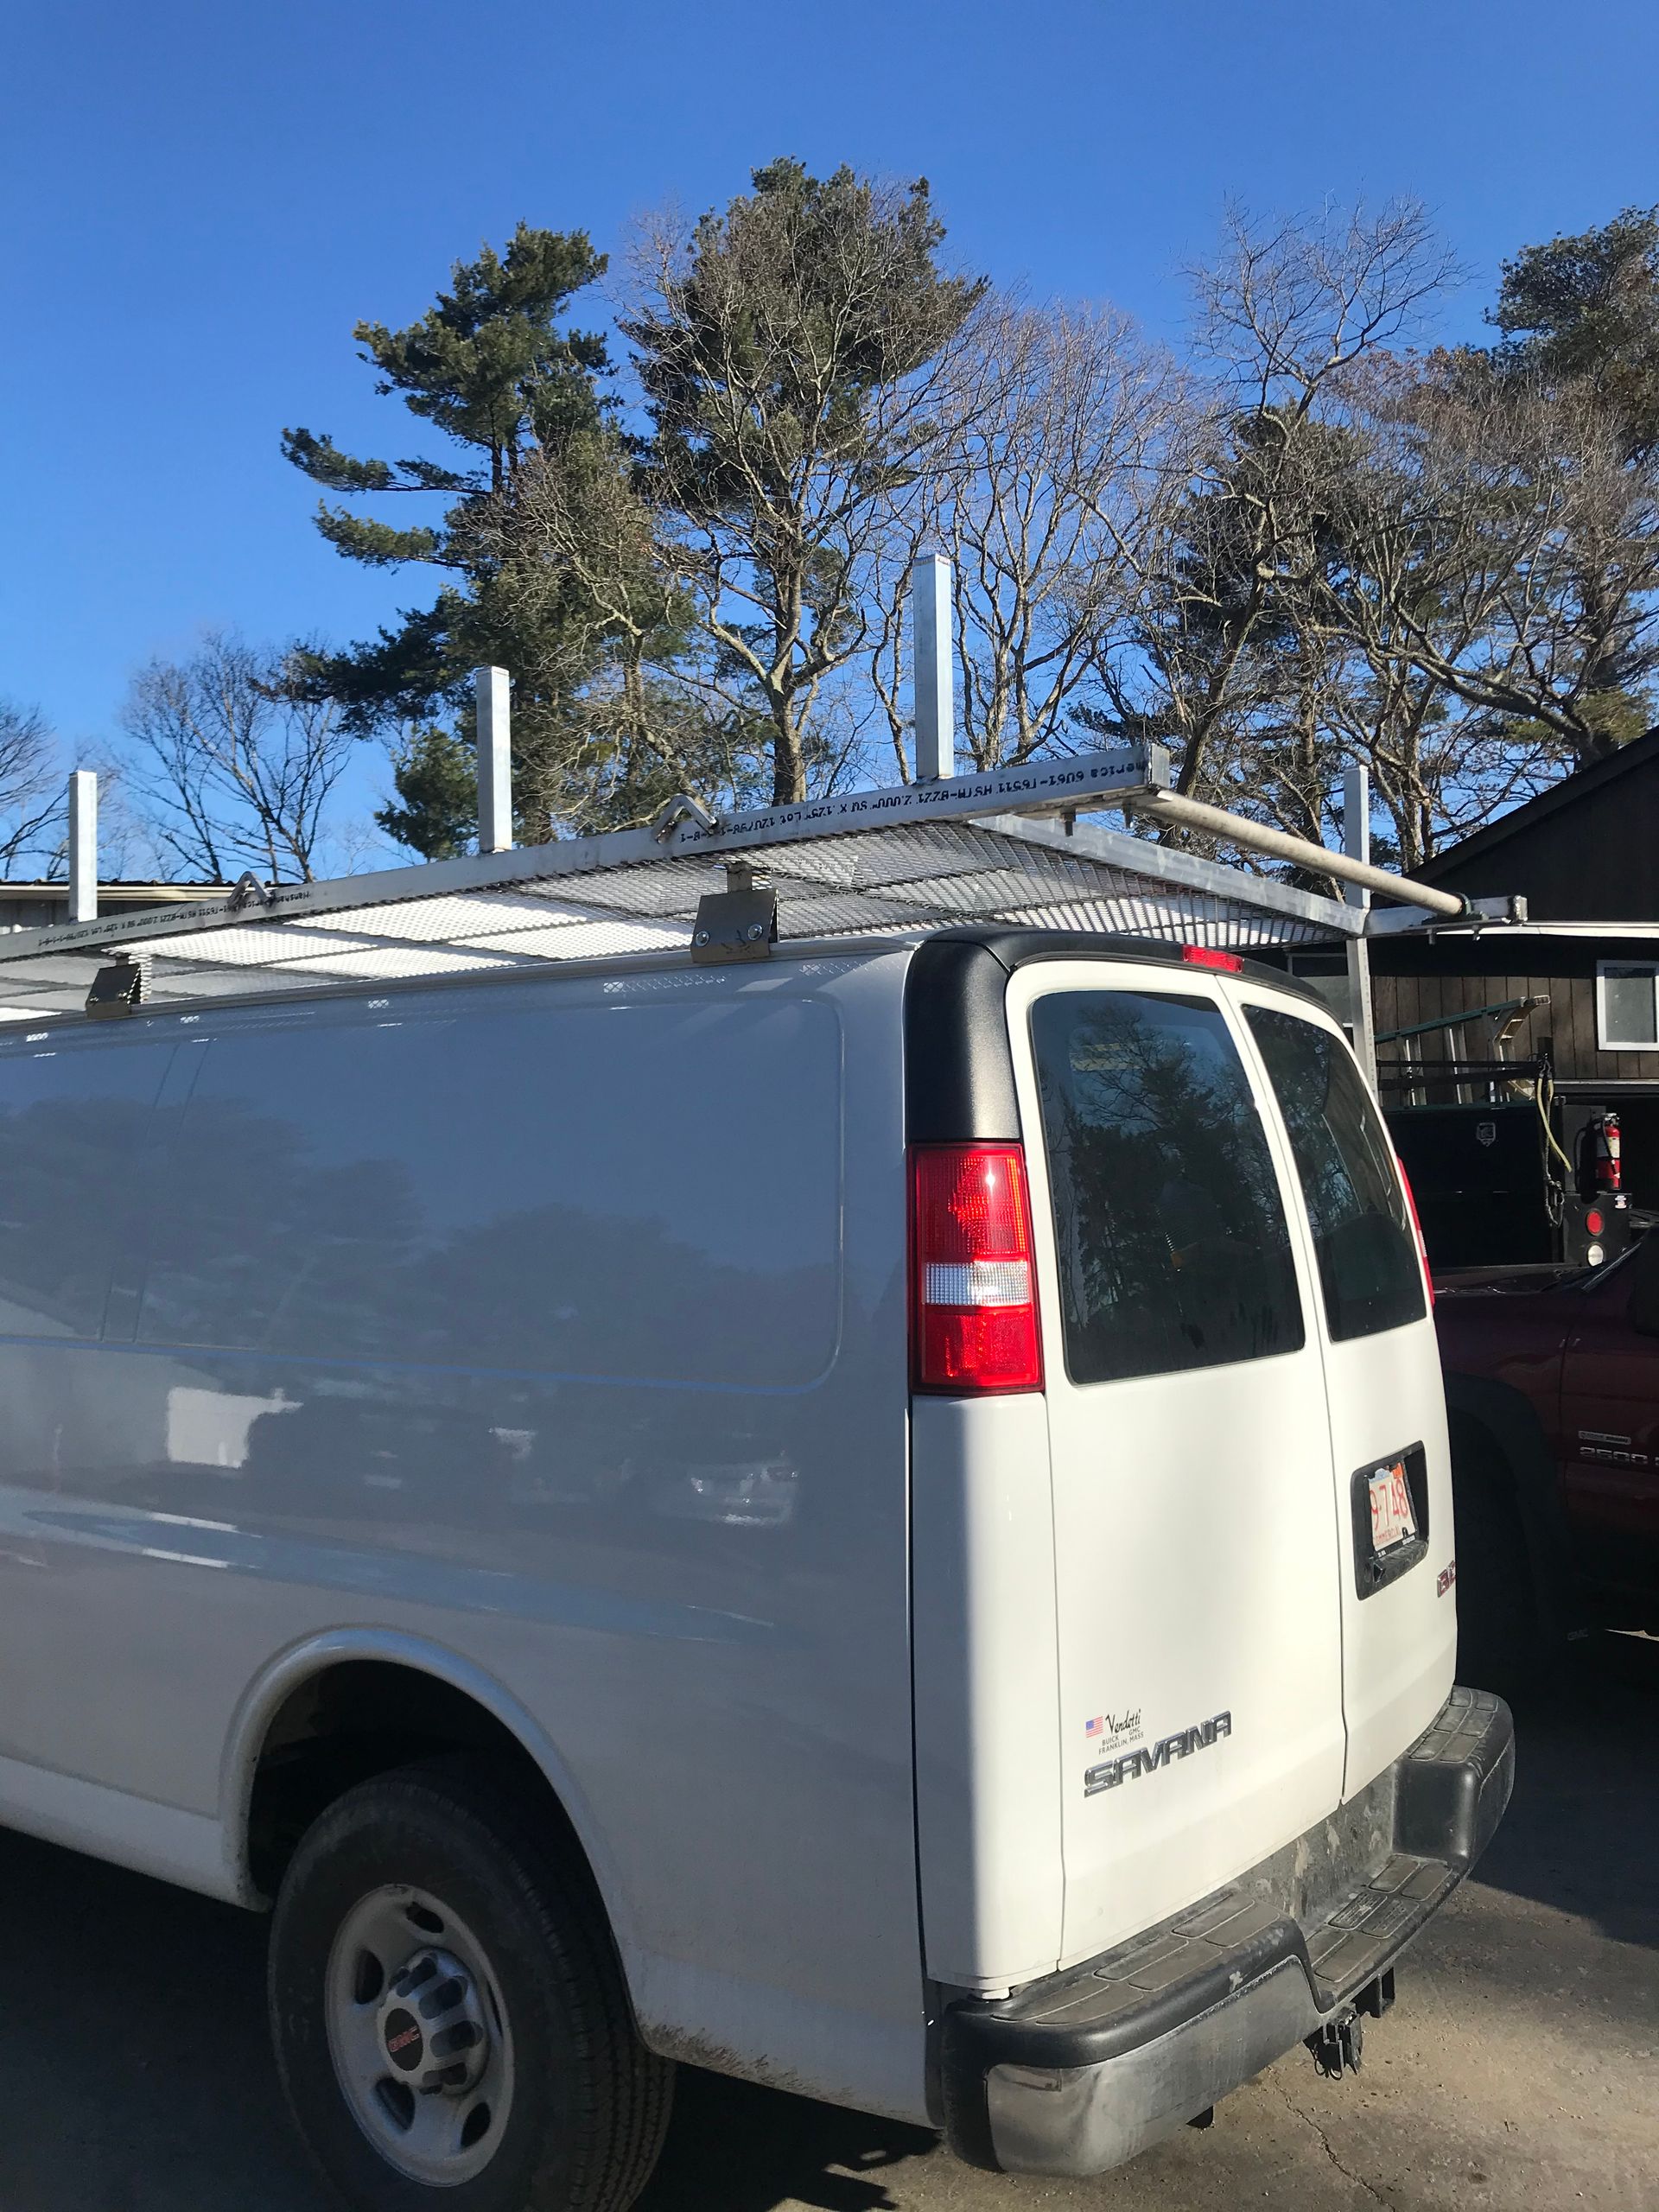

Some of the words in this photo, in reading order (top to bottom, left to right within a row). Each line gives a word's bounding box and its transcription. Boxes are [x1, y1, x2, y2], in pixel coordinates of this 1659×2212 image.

[779, 811, 802, 825] Lot
[1102, 1734, 1119, 1746] BUICK
[1128, 1726, 1141, 1736] GMC
[1129, 1732, 1144, 1743] MASS
[1084, 1710, 1232, 1798] SAVANA
[386, 2024, 421, 2053] GMC
